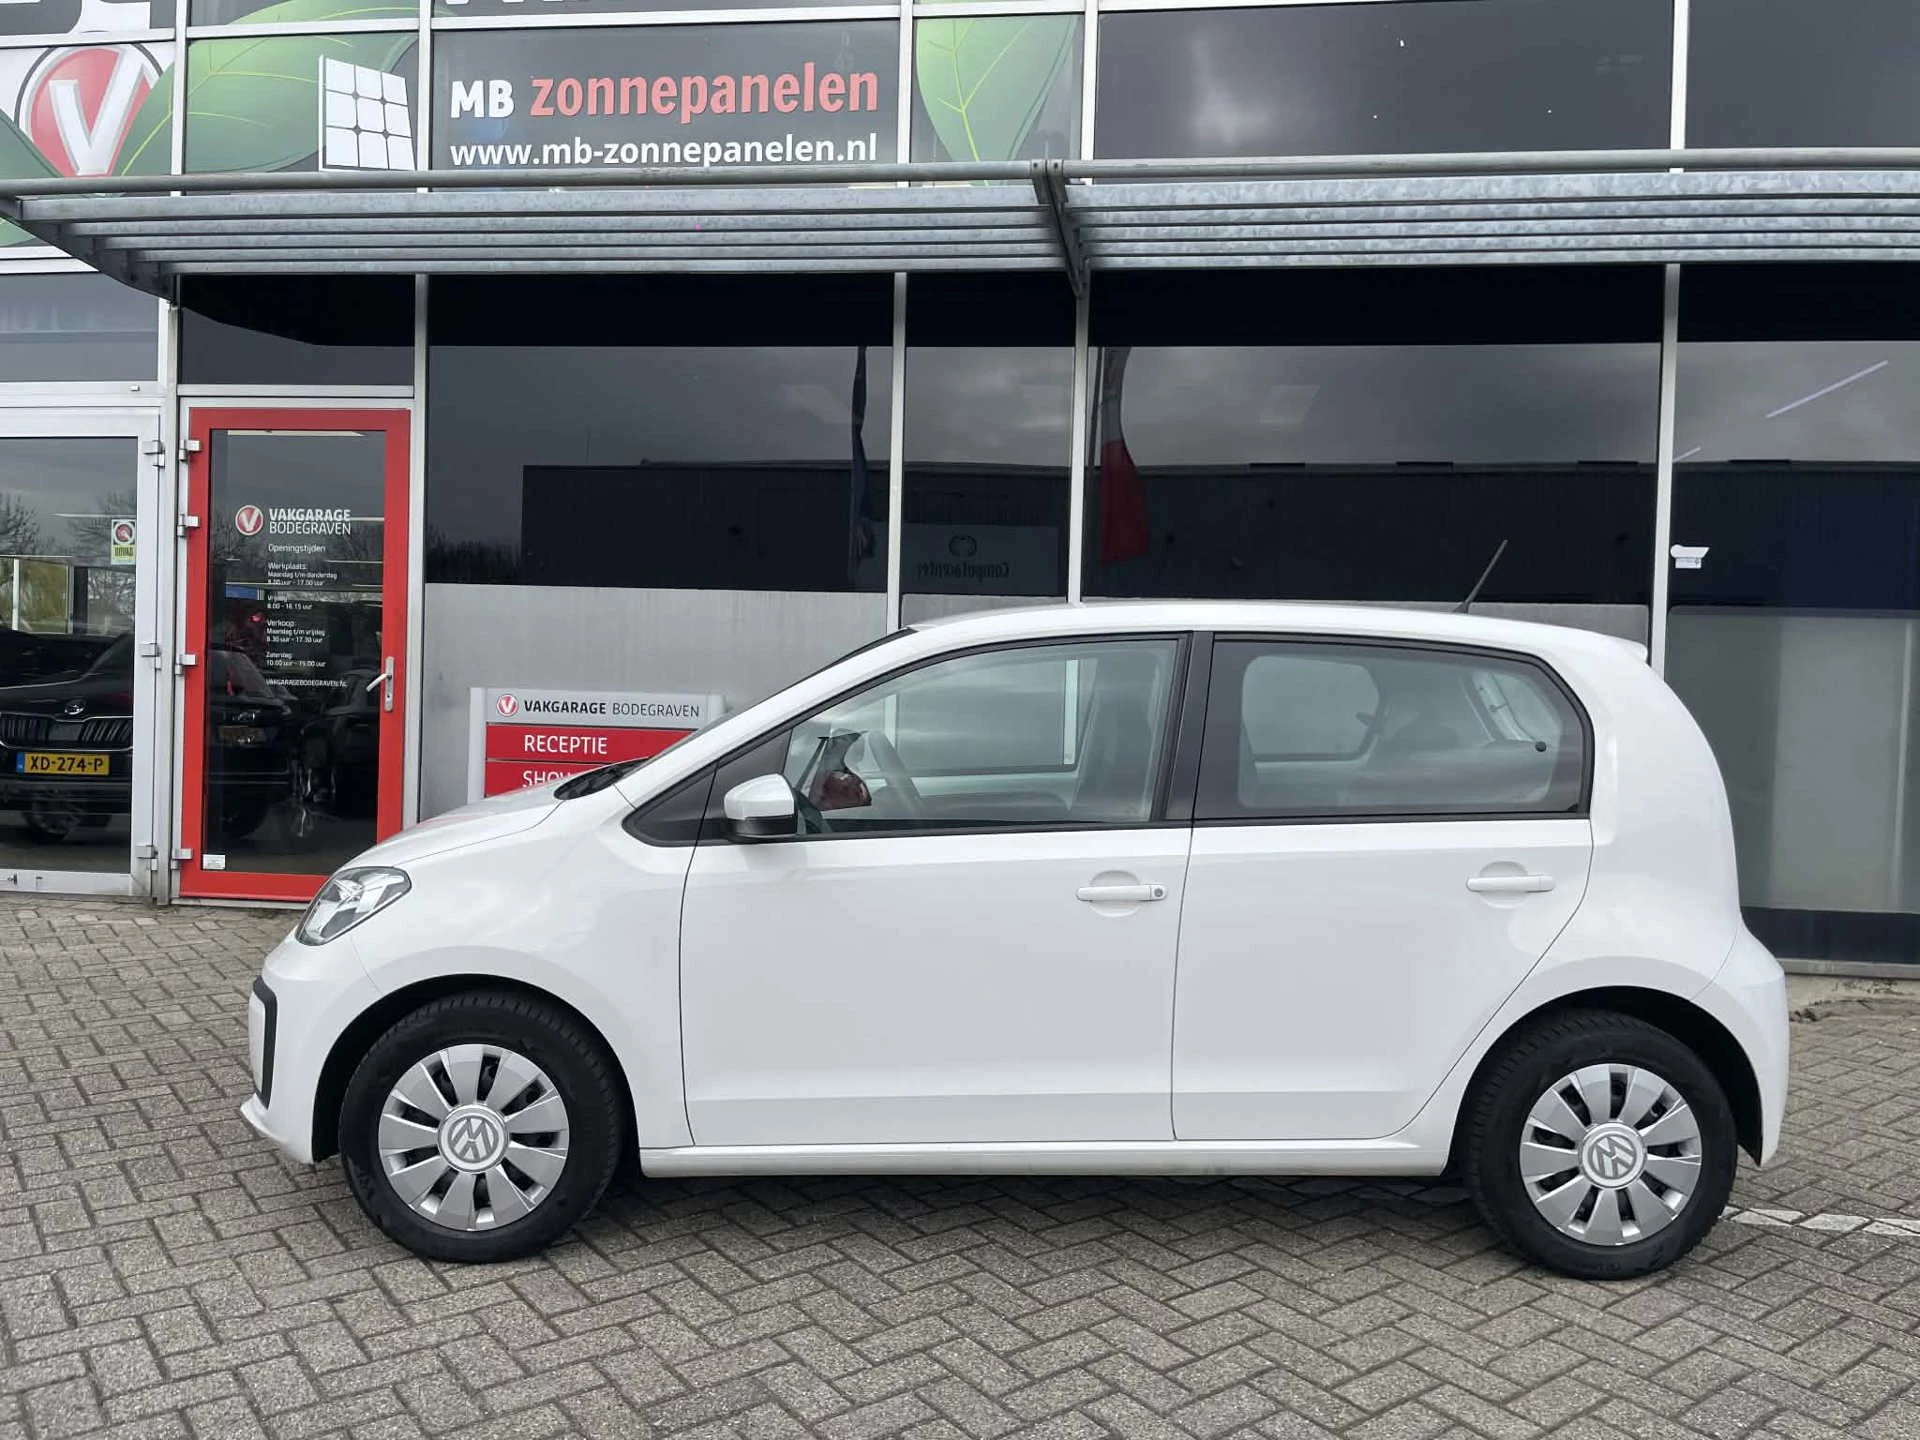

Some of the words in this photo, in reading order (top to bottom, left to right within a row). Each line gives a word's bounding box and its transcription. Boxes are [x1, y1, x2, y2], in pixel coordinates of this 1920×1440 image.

[450, 80, 514, 118] MB
[530, 61, 878, 124] zonnepanelen
[450, 133, 877, 167] www.mb-zonnepanelen.nl
[269, 508, 351, 521] VAKGARAGE
[269, 521, 351, 535] BODEGRAVEN
[268, 544, 326, 554] Openingstijden
[524, 700, 606, 715] VAKGARAGE
[612, 703, 700, 718] BODEGRAVEN
[524, 734, 608, 755] RECEPTIE
[30, 755, 104, 772] XD-274-P
